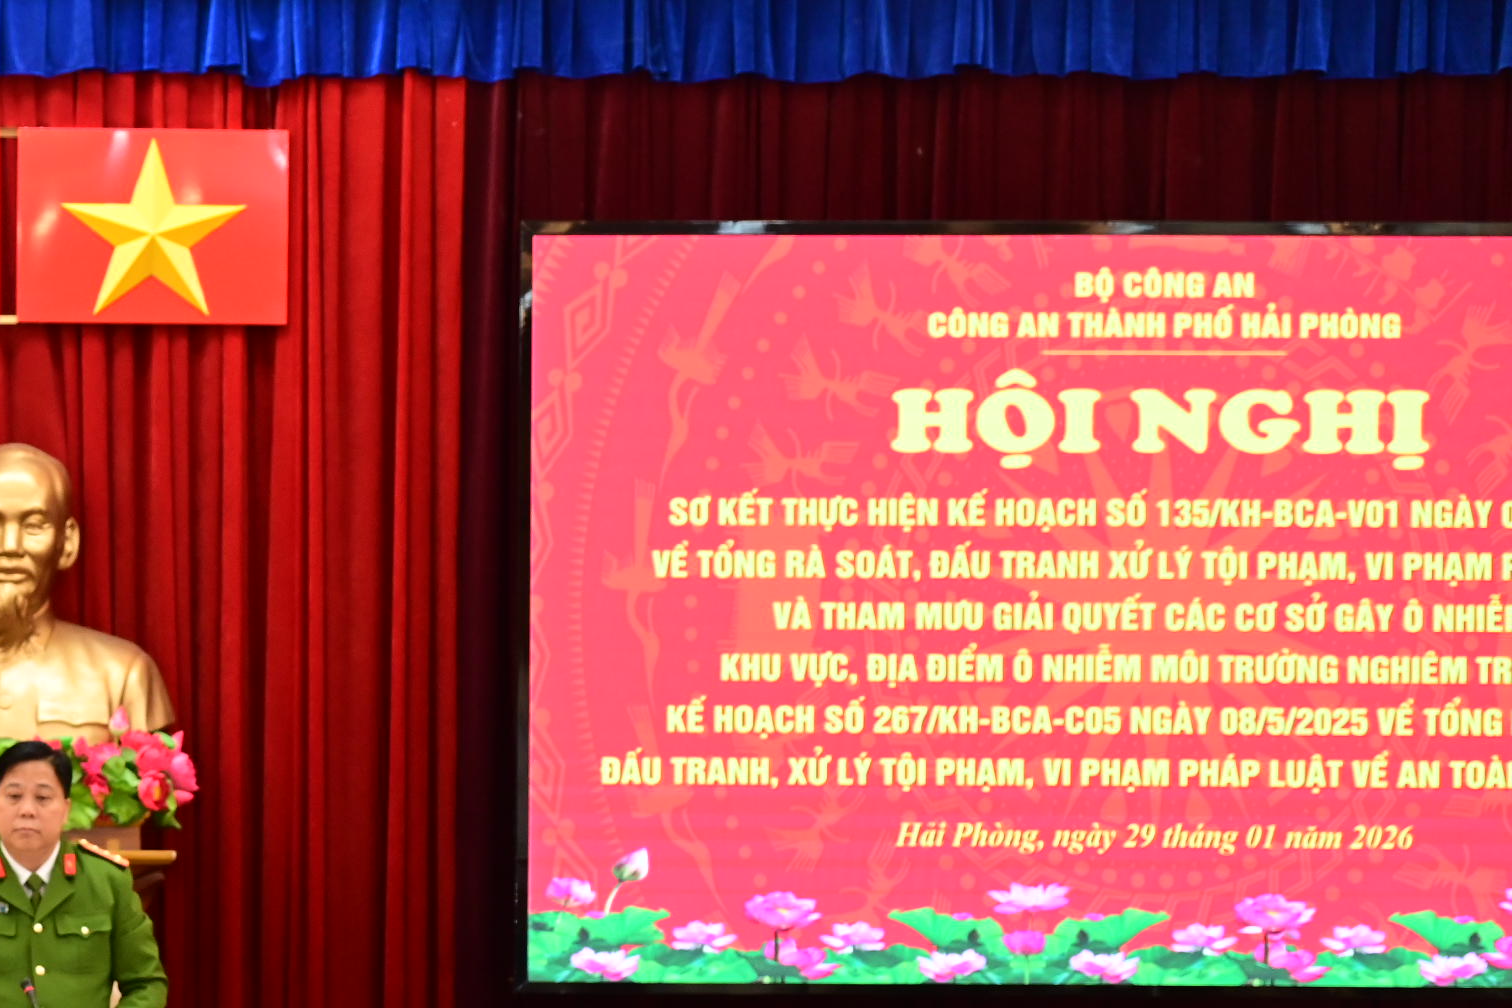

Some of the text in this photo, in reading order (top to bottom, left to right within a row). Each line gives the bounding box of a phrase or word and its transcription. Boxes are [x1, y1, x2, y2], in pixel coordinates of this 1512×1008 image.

[1074, 266, 1256, 304] BỘ CÔNG AN
[927, 302, 1402, 339] CÔNG AN THÀNH PHỐ HẢI PHÒNG
[890, 367, 1431, 471] HỘI NGHỊ
[668, 495, 712, 527] SƠ
[717, 488, 774, 527] KẾT
[780, 495, 859, 532] THỰC
[867, 492, 939, 533] HIỆN
[947, 488, 988, 527] KẾ
[994, 497, 1097, 533] HOẠCH
[1105, 488, 1148, 528] SỐ
[1155, 497, 1399, 529] 135/KH-BCA-V01
[1410, 494, 1493, 529] NGÀY
[651, 540, 689, 579] VỀ
[696, 539, 777, 579] TỔNG
[784, 543, 826, 579] RÀ
[835, 543, 922, 582] SOÁT,
[928, 540, 991, 580] ĐẤU
[999, 549, 1100, 580] TRANH
[1107, 539, 1154, 580] XỬ
[1157, 544, 1193, 580] LÝ
[1200, 544, 1249, 587] TỘI
[1257, 551, 1357, 587] PHẠM,
[1364, 551, 1394, 581] VI
[1402, 551, 1493, 587] PHẠM
[772, 591, 1512, 635] VÀ THAM MƯU GIẢI QUYẾT CÁC CƠ SỞ GÂY Ô NHIỄ
[720, 652, 782, 683] KHU
[789, 650, 858, 688] VỰC,
[866, 652, 919, 689] ĐỊA
[925, 642, 1004, 683] ĐIỂM
[1012, 647, 1033, 683] Ô
[1042, 643, 1142, 683] NHIỄM
[1150, 648, 1210, 684] MÔI
[1217, 647, 1339, 684] TRƯỜNG
[1346, 650, 1468, 685] NGHIÊM
[666, 695, 707, 734] KẾ
[713, 704, 815, 740] HOẠCH
[823, 695, 866, 734] SỐ
[873, 705, 1122, 735] 267/KH-BCA-C05
[1129, 700, 1212, 736] NGÀY
[1219, 705, 1369, 737] 08/5/2025
[1376, 697, 1415, 737] VỀ
[1422, 696, 1503, 737] TỔNG
[599, 746, 1512, 794] ĐẤU TRANH, XỬ LÝ TỘI PHẠM, VI PHẠM PHÁP LUẬT VỀ AN TOÀ
[895, 821, 1413, 855] Hải Phòng, ngày 29 tháng 01 năm 2026
